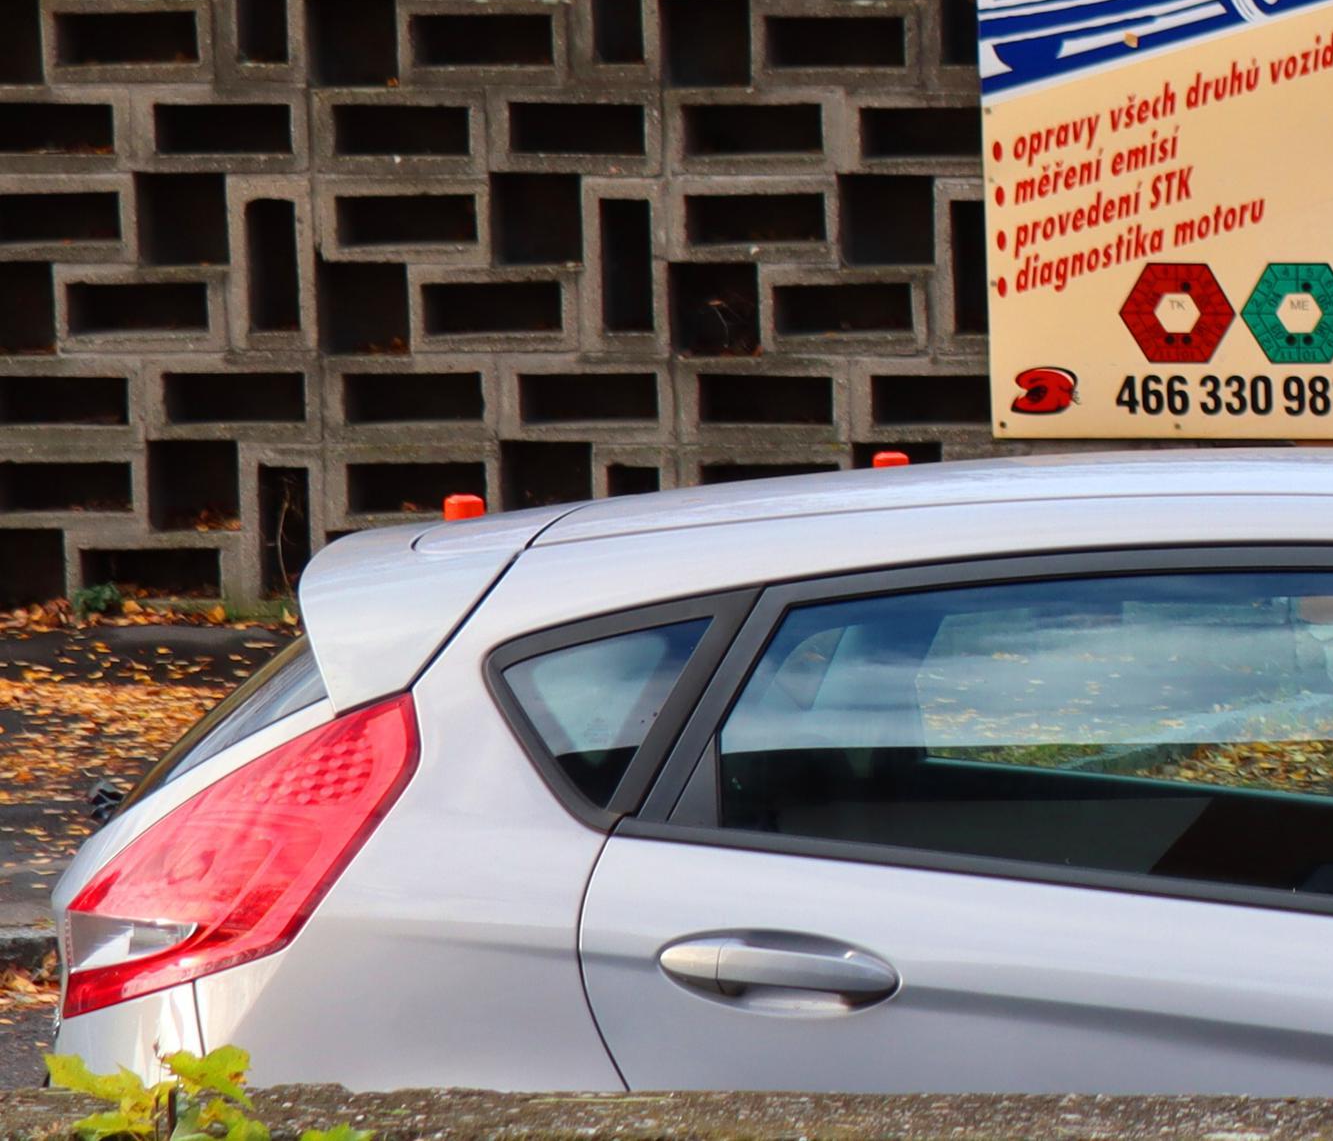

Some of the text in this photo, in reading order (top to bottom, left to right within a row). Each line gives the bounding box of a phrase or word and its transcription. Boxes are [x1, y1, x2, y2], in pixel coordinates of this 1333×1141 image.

[1013, 114, 1100, 167] opravy
[1110, 82, 1176, 132] všech
[1014, 125, 1180, 205] měření emisí
[1014, 166, 1194, 258] provedení STK
[1015, 198, 1265, 293] diagnostika motoru
[1290, 299, 1309, 311] ME
[1116, 375, 1190, 416] 466
[1200, 375, 1274, 416] 330
